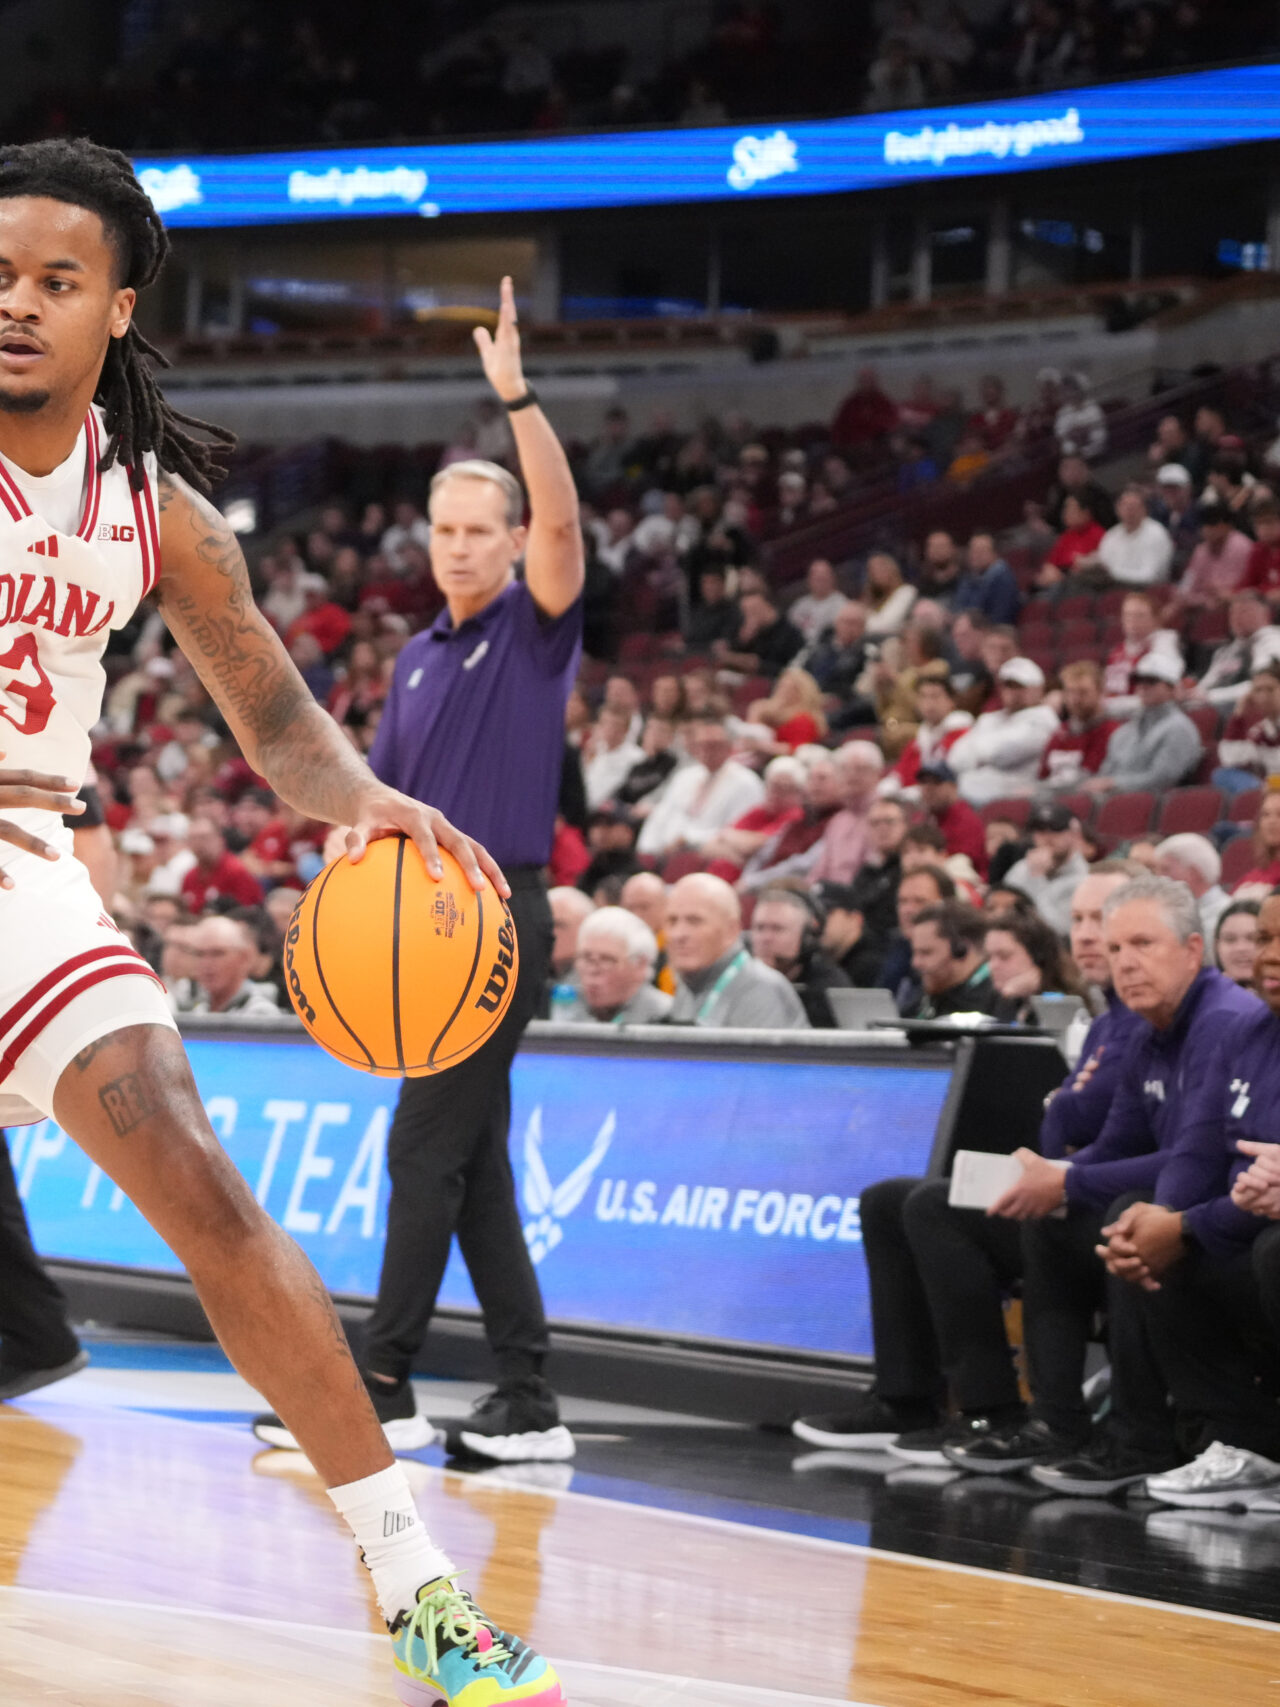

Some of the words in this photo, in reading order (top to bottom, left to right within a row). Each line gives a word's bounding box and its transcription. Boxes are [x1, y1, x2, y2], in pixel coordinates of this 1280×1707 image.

[254, 1100, 394, 1240] TEA
[595, 1178, 659, 1225] U.S.
[660, 1184, 730, 1231] AIR
[728, 1189, 863, 1243] FORCE
